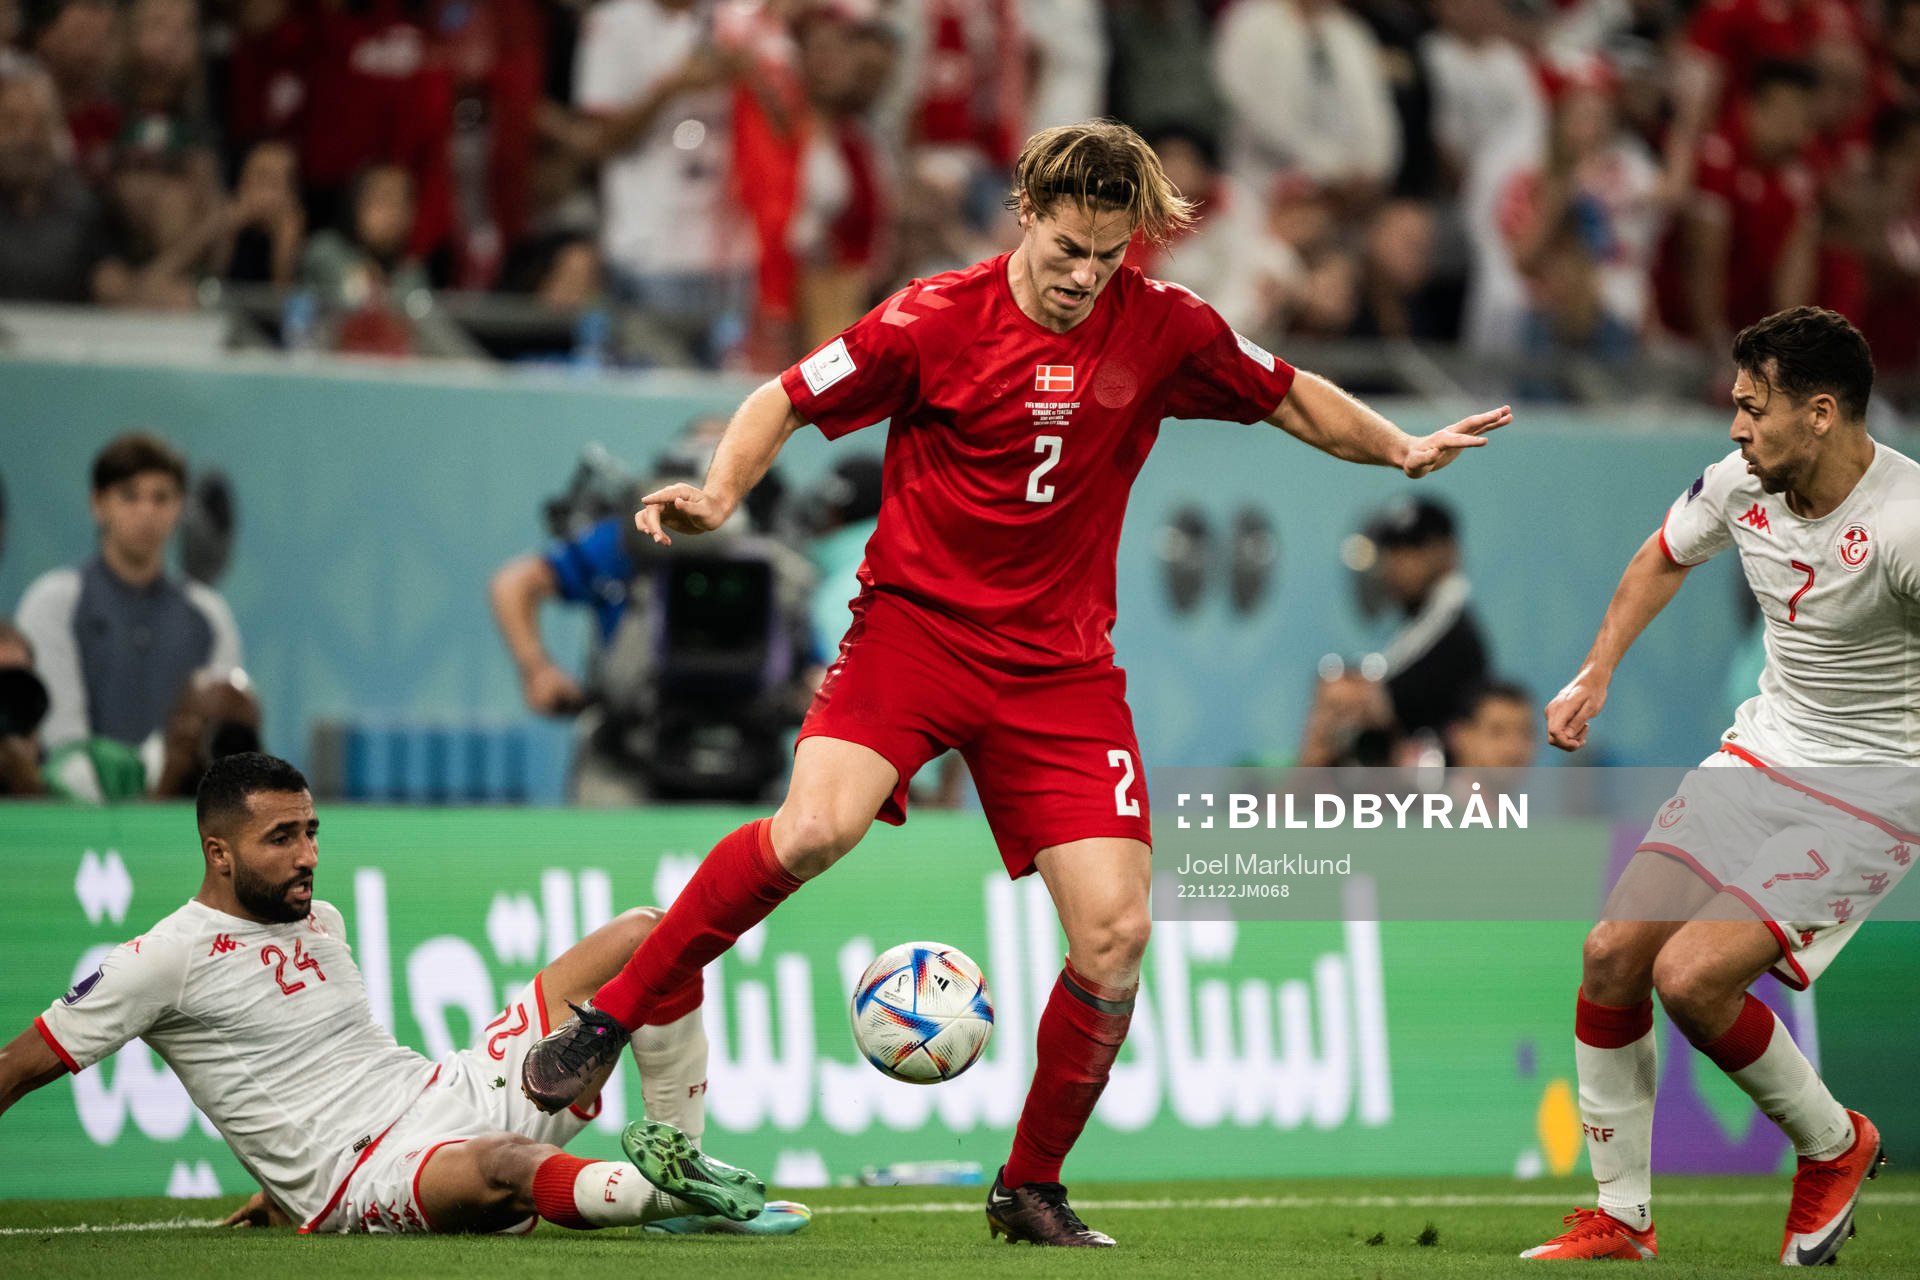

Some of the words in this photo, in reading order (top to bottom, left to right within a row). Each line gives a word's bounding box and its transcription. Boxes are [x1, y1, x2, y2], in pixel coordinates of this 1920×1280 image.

[1025, 434, 1063, 503] 2
[1788, 559, 1815, 622] 7
[1107, 749, 1141, 818] 2
[1762, 849, 1830, 890] 7
[260, 937, 326, 996] 24
[1582, 1122, 1615, 1143] FTF
